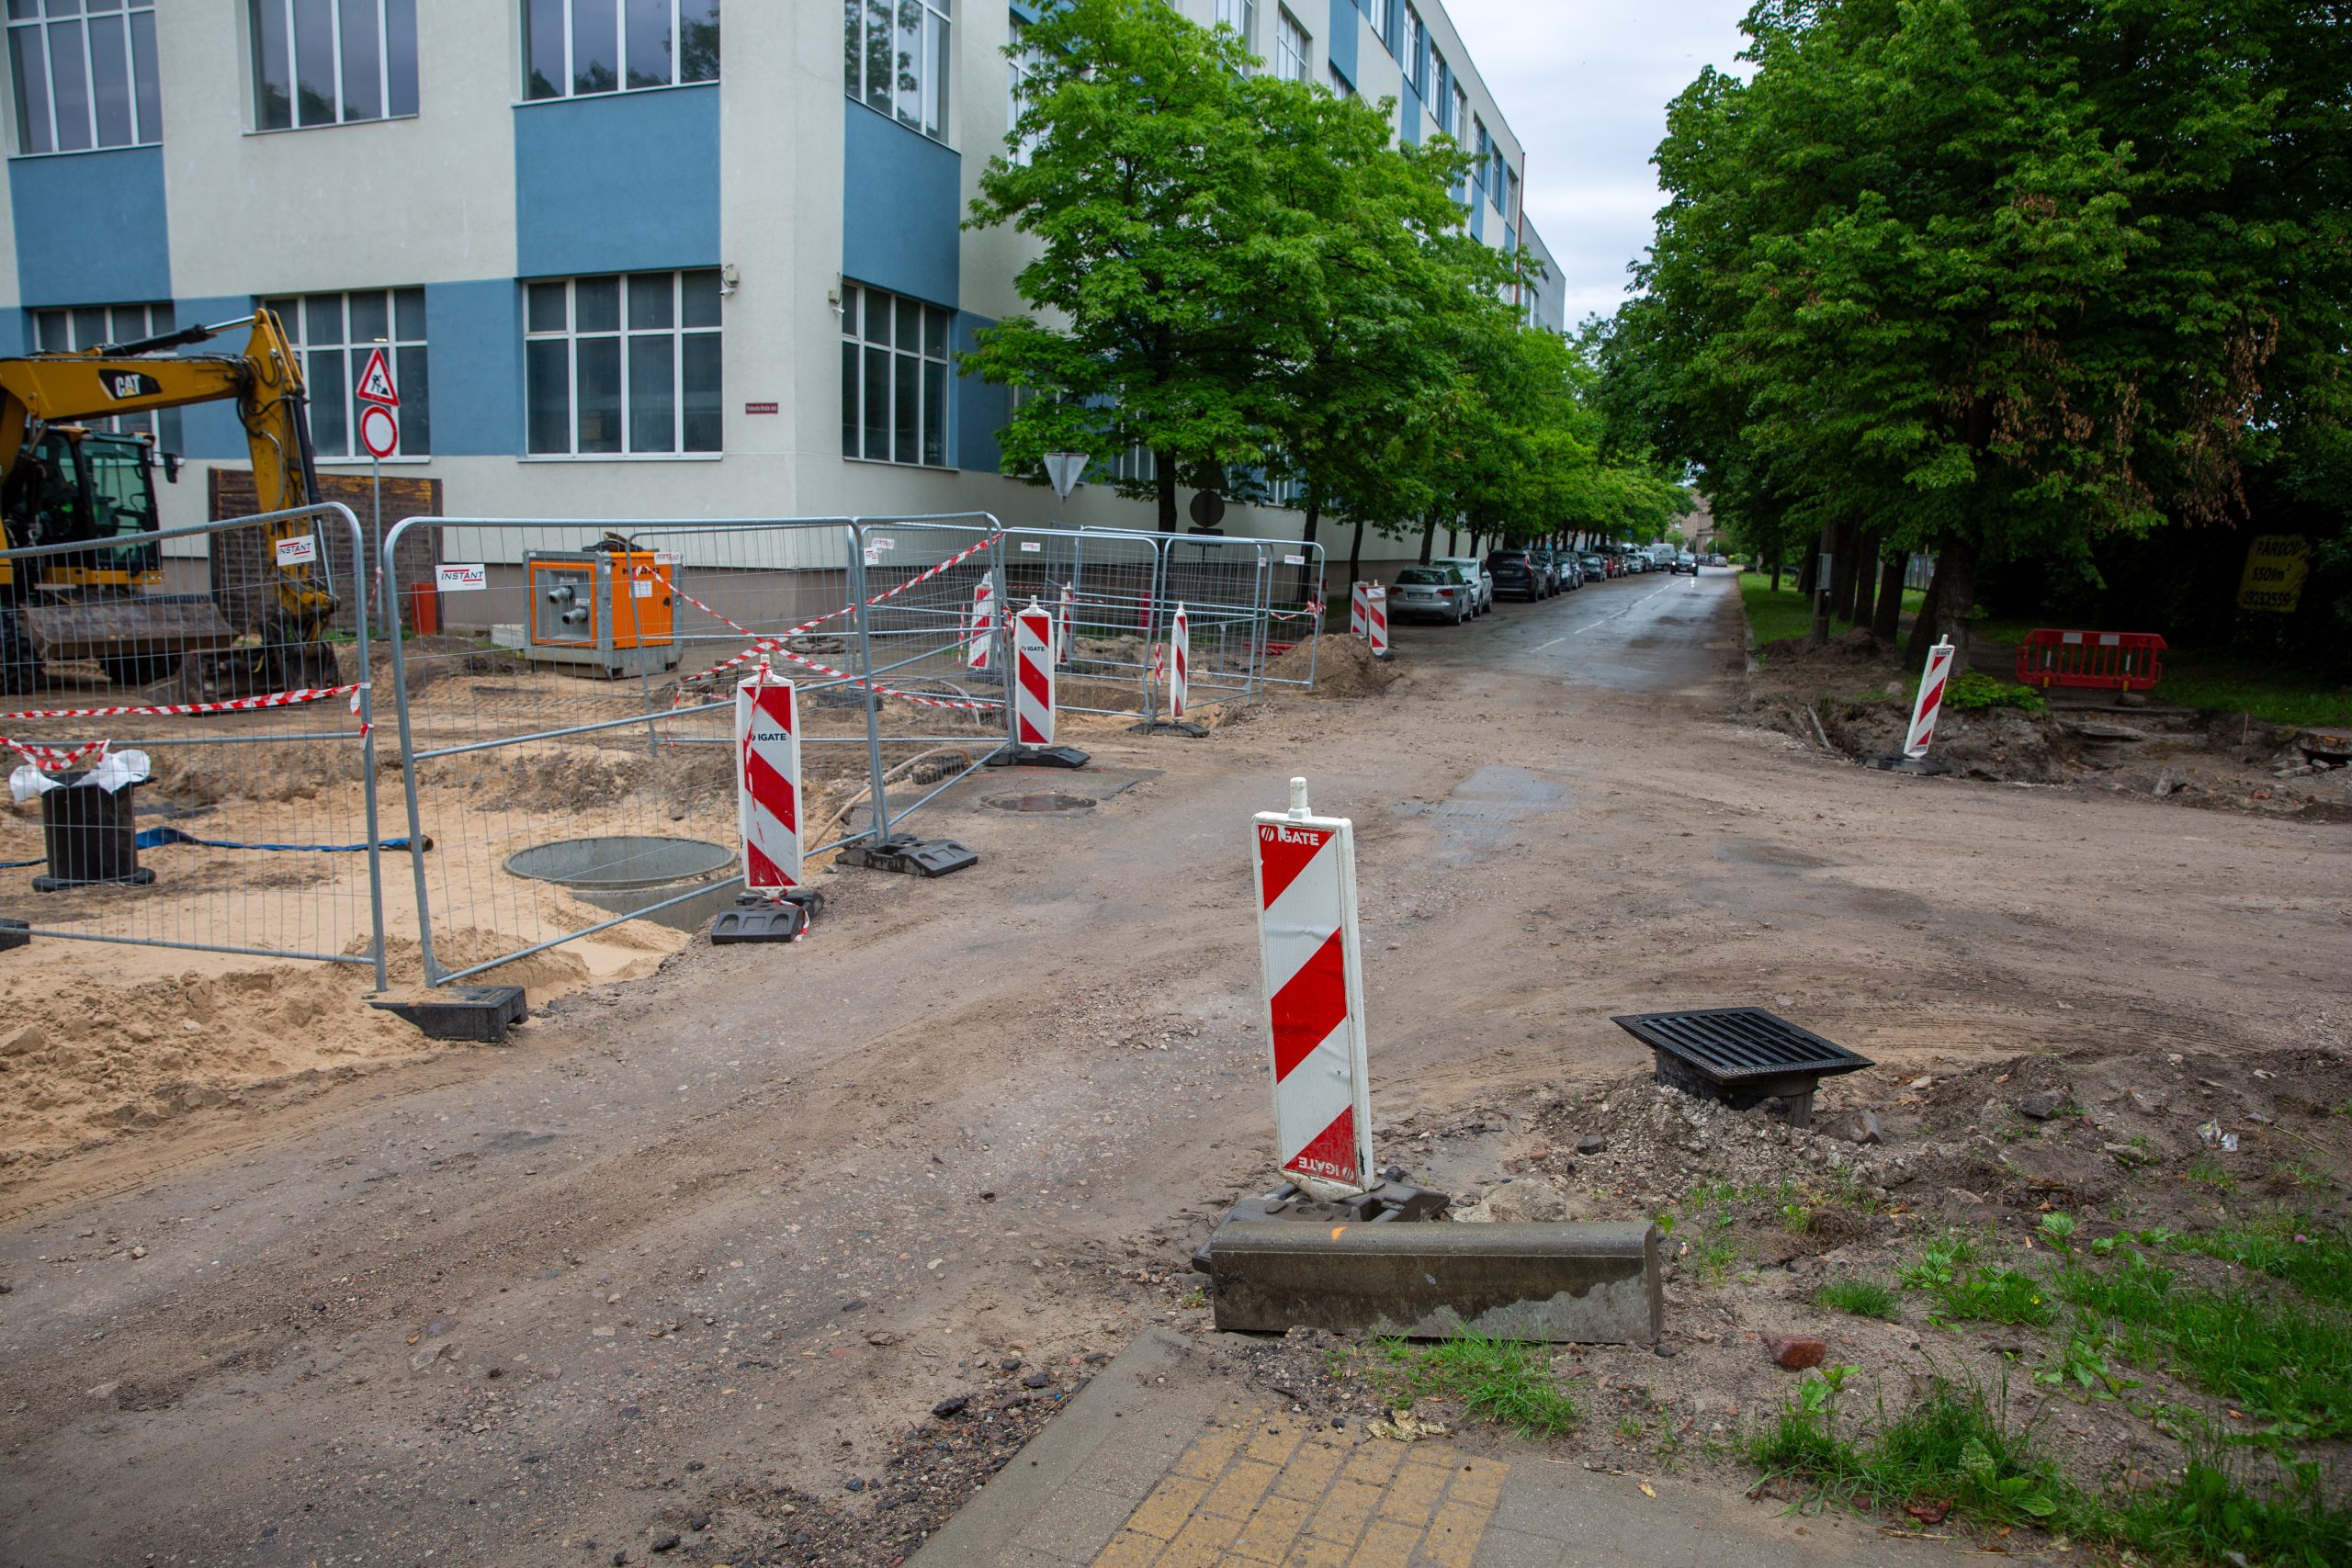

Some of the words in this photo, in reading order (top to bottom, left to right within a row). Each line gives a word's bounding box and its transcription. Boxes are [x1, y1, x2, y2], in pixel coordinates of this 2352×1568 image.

[115, 374, 141, 397] CAT
[278, 543, 311, 555] INSTANT
[441, 571, 483, 581] INSTANT
[758, 733, 786, 741] IGATE
[1277, 828, 1319, 846] IGATE
[1298, 1156, 1340, 1176] IGATE
